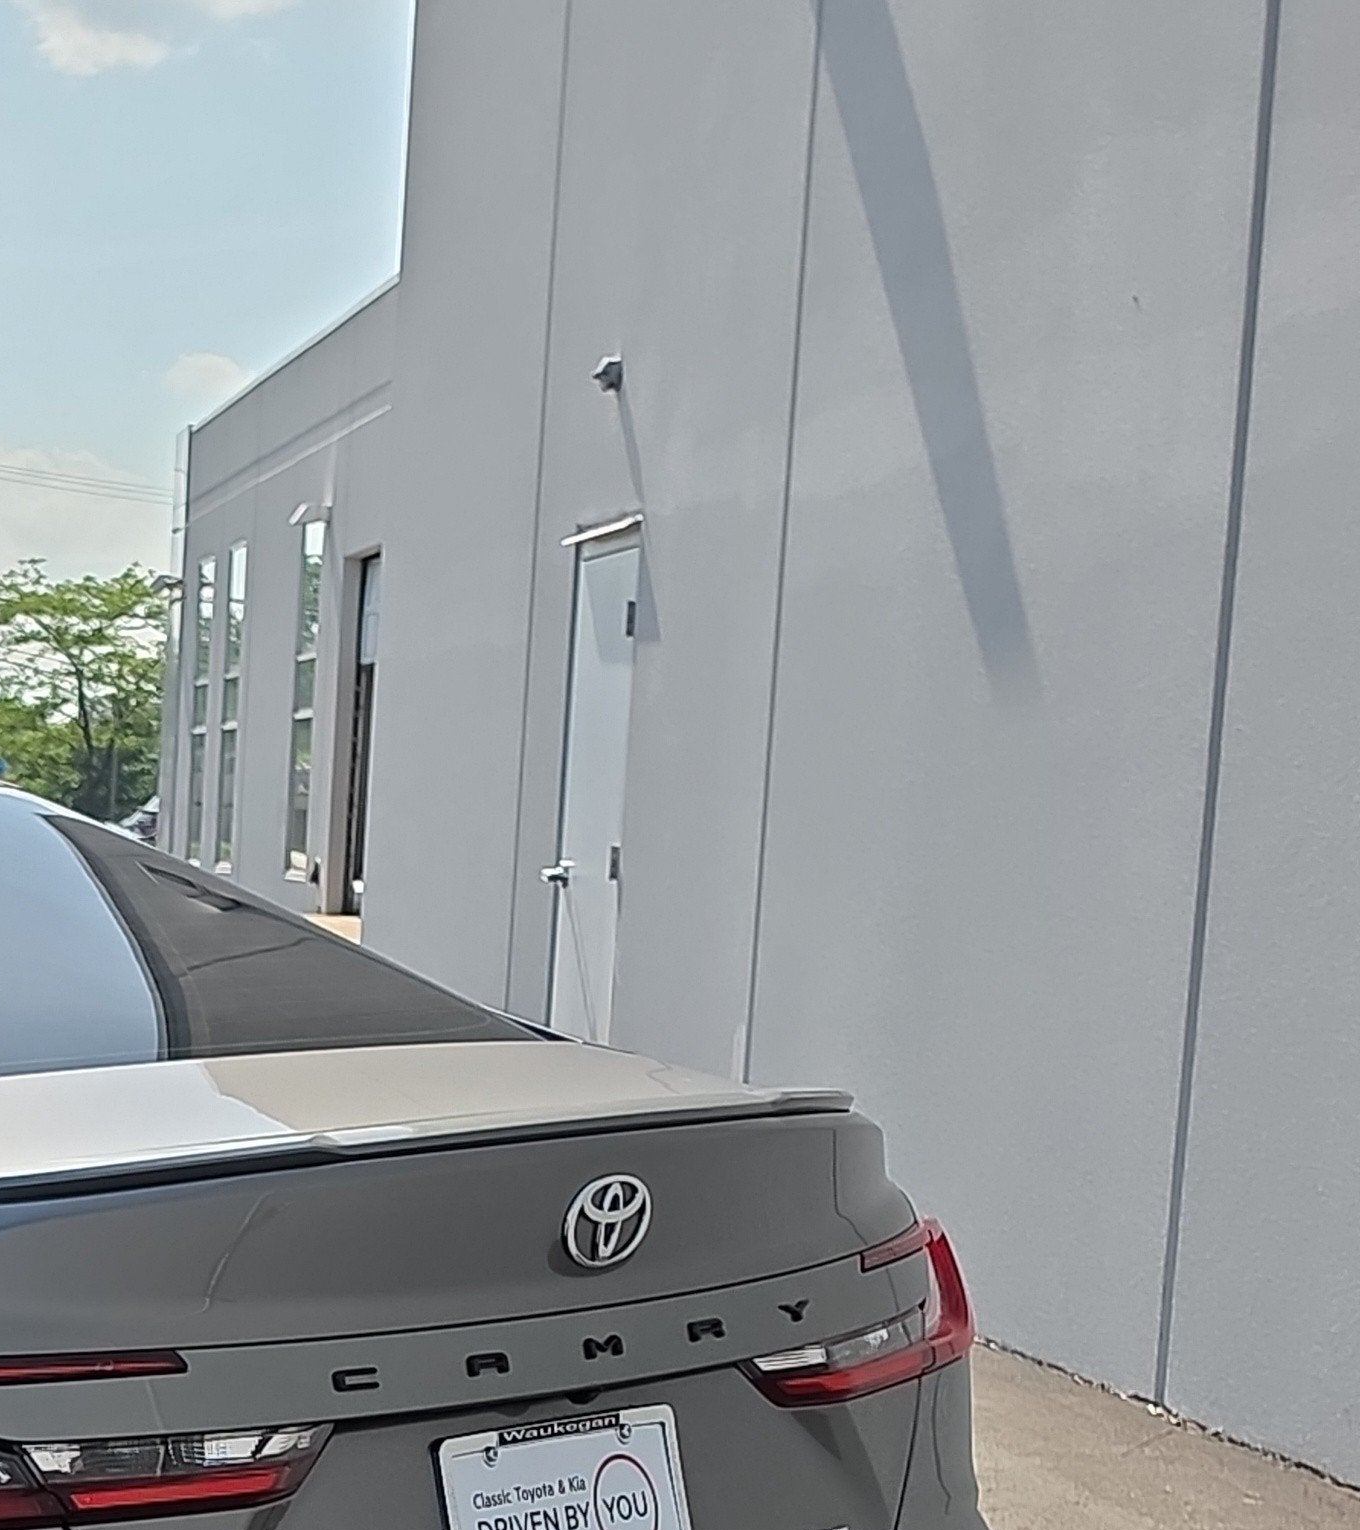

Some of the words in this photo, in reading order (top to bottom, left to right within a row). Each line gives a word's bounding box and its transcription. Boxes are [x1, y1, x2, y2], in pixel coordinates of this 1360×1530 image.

[331, 1299, 811, 1393] CAMRY
[472, 1489, 512, 1510] Classic
[513, 1483, 555, 1504] Toyota
[558, 1479, 566, 1495] &
[567, 1475, 587, 1492] Kia
[564, 1501, 590, 1530] BY
[602, 1490, 649, 1524] YOU
